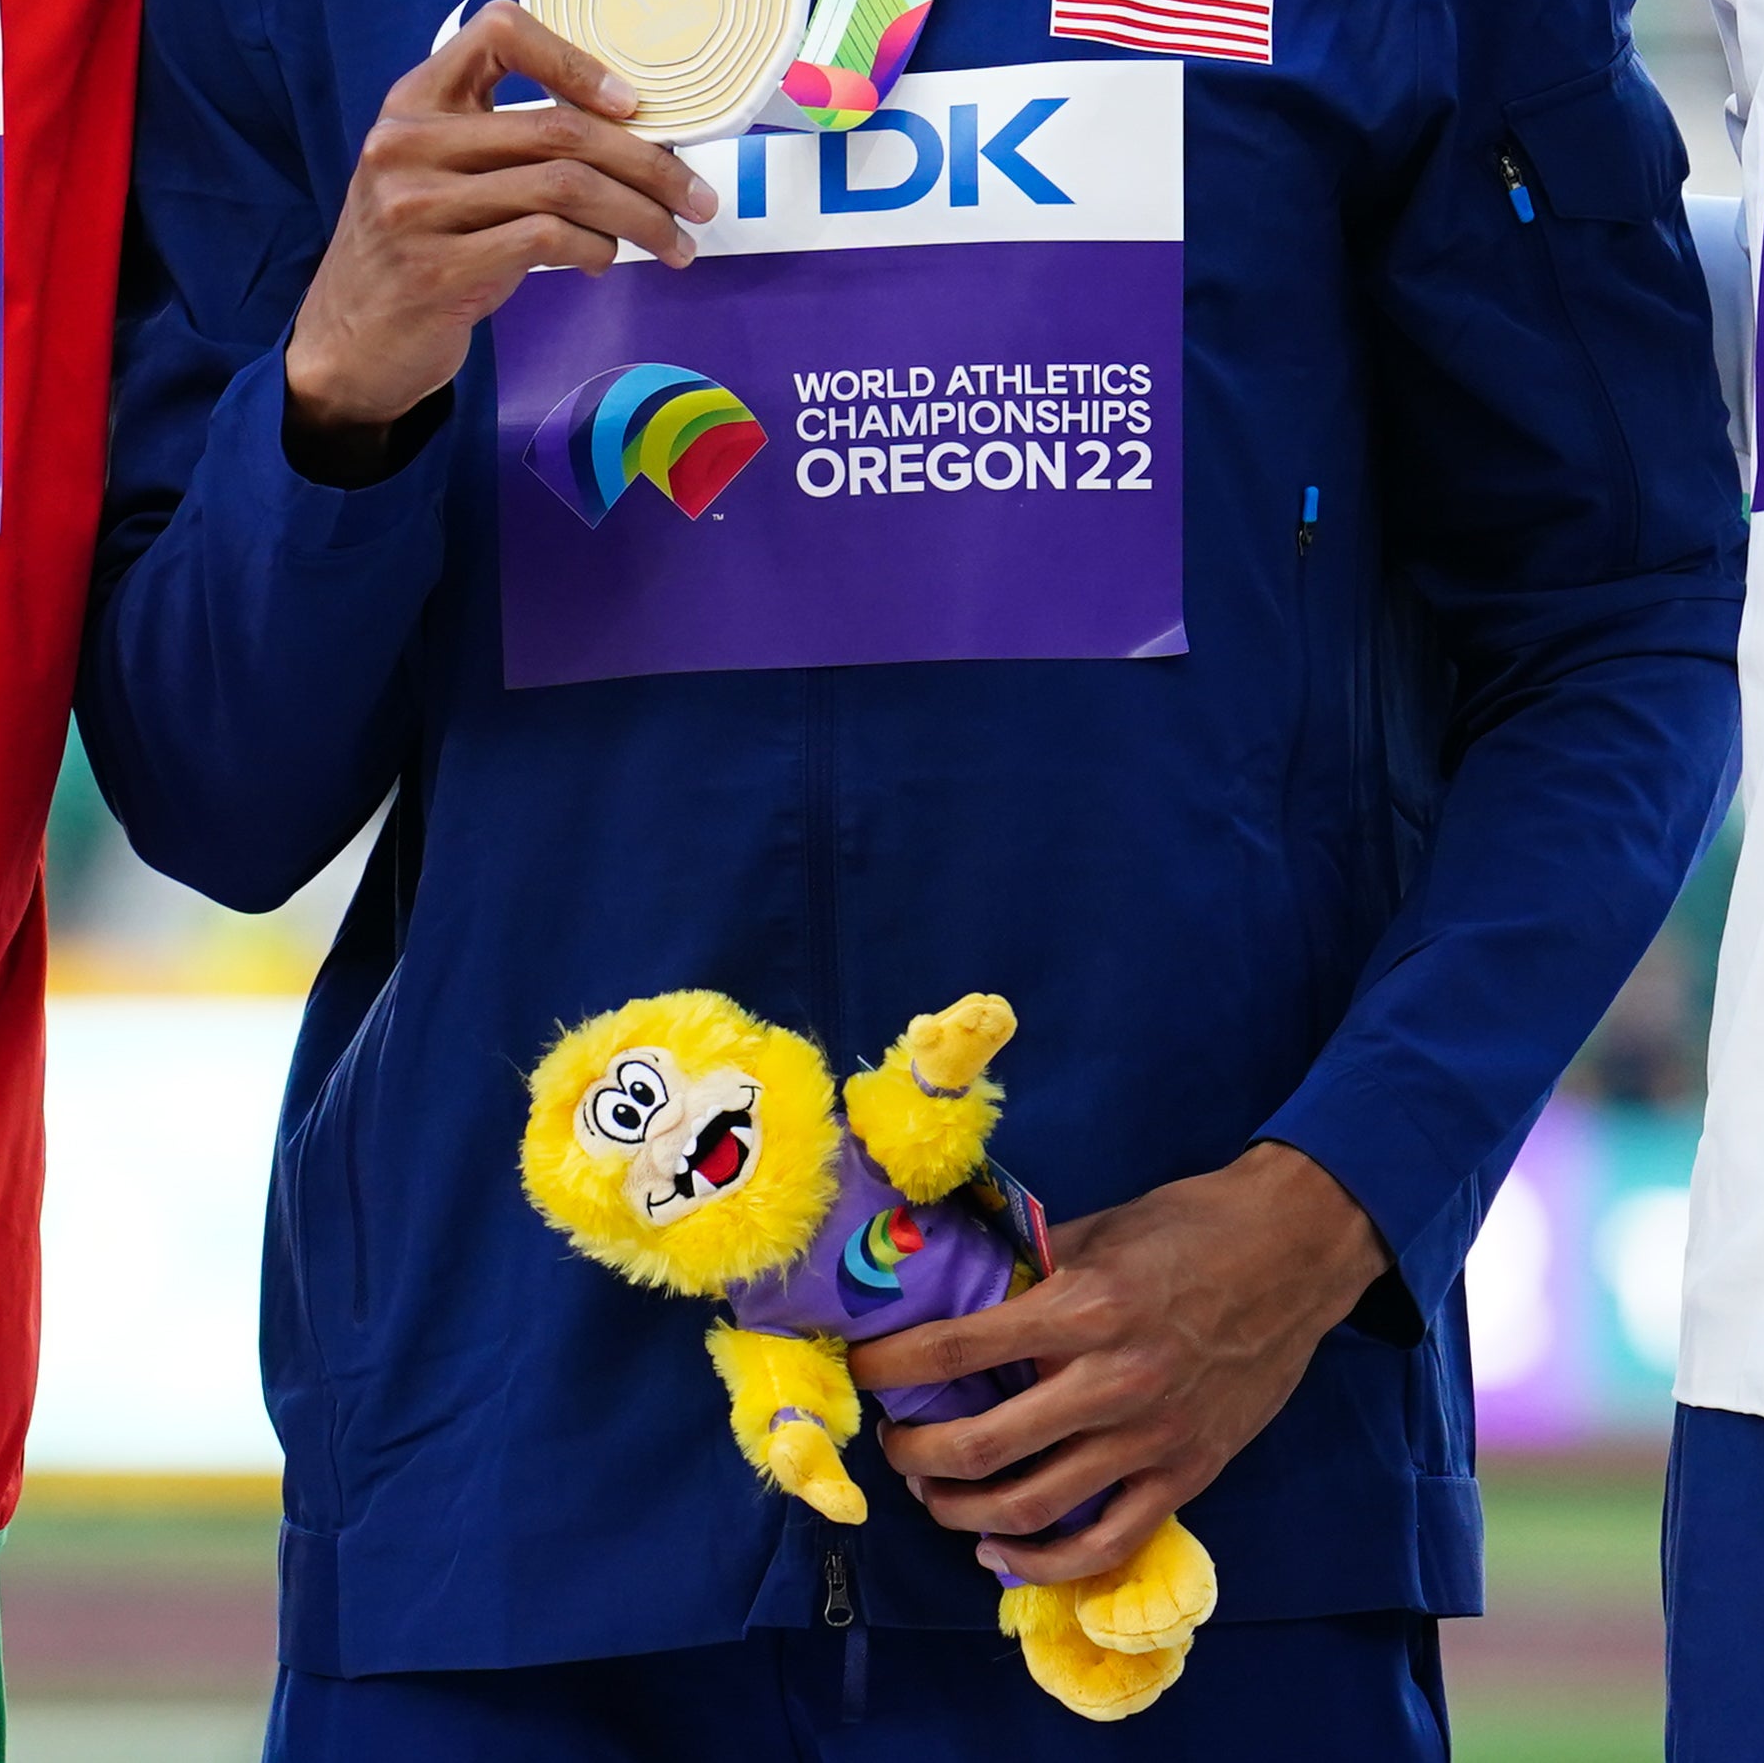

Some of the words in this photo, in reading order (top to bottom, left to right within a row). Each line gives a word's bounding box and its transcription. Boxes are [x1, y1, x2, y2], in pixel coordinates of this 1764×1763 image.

[793, 366, 936, 403] WORLD
[945, 364, 1152, 396] ATHLETICS
[796, 400, 1152, 442] CHAMPIONSHIPS
[796, 440, 1066, 498] OREGON
[1075, 440, 1152, 490] 22
